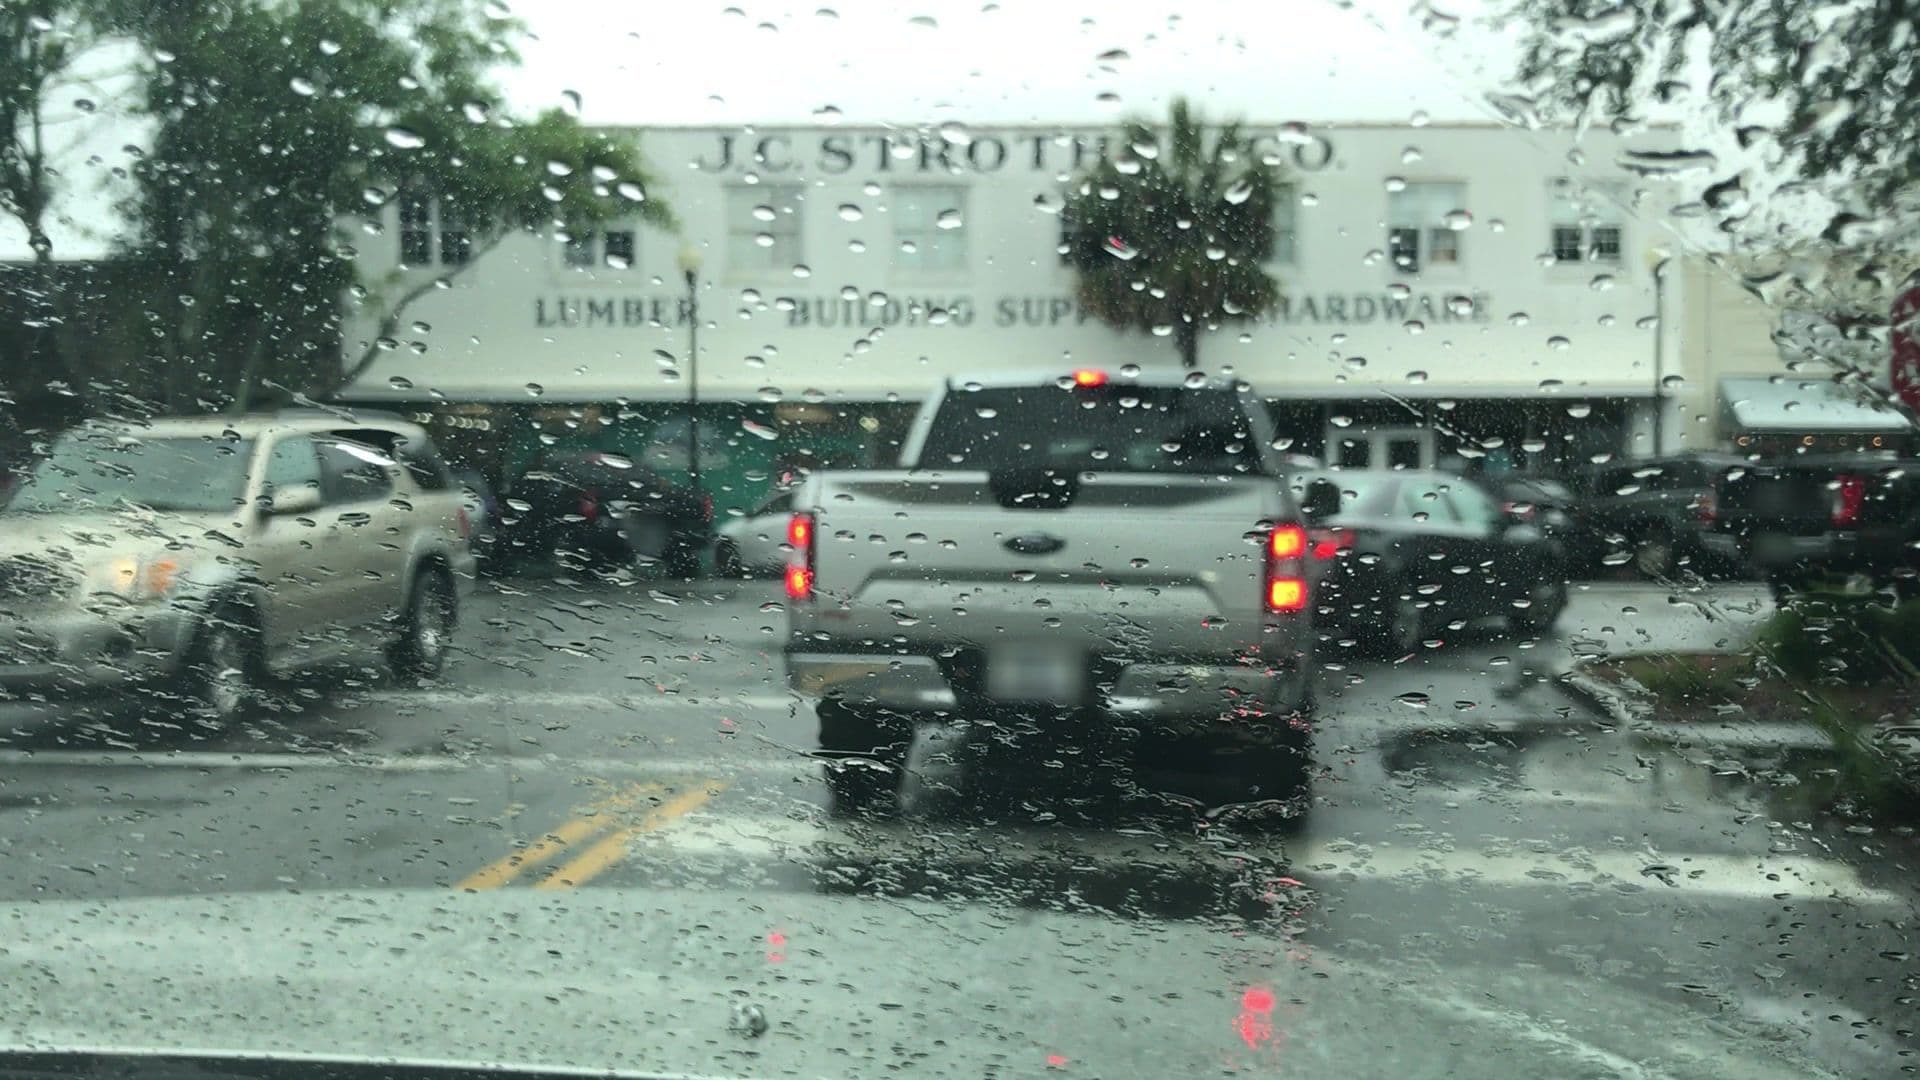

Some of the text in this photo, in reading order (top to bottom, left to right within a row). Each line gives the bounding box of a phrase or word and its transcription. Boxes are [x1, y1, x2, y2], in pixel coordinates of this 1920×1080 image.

[698, 134, 802, 173] J.C.
[816, 133, 1150, 173] STROTH
[535, 296, 698, 328] LUMBER
[787, 295, 976, 328] BUILDING
[1266, 291, 1493, 325] HARDWARE
